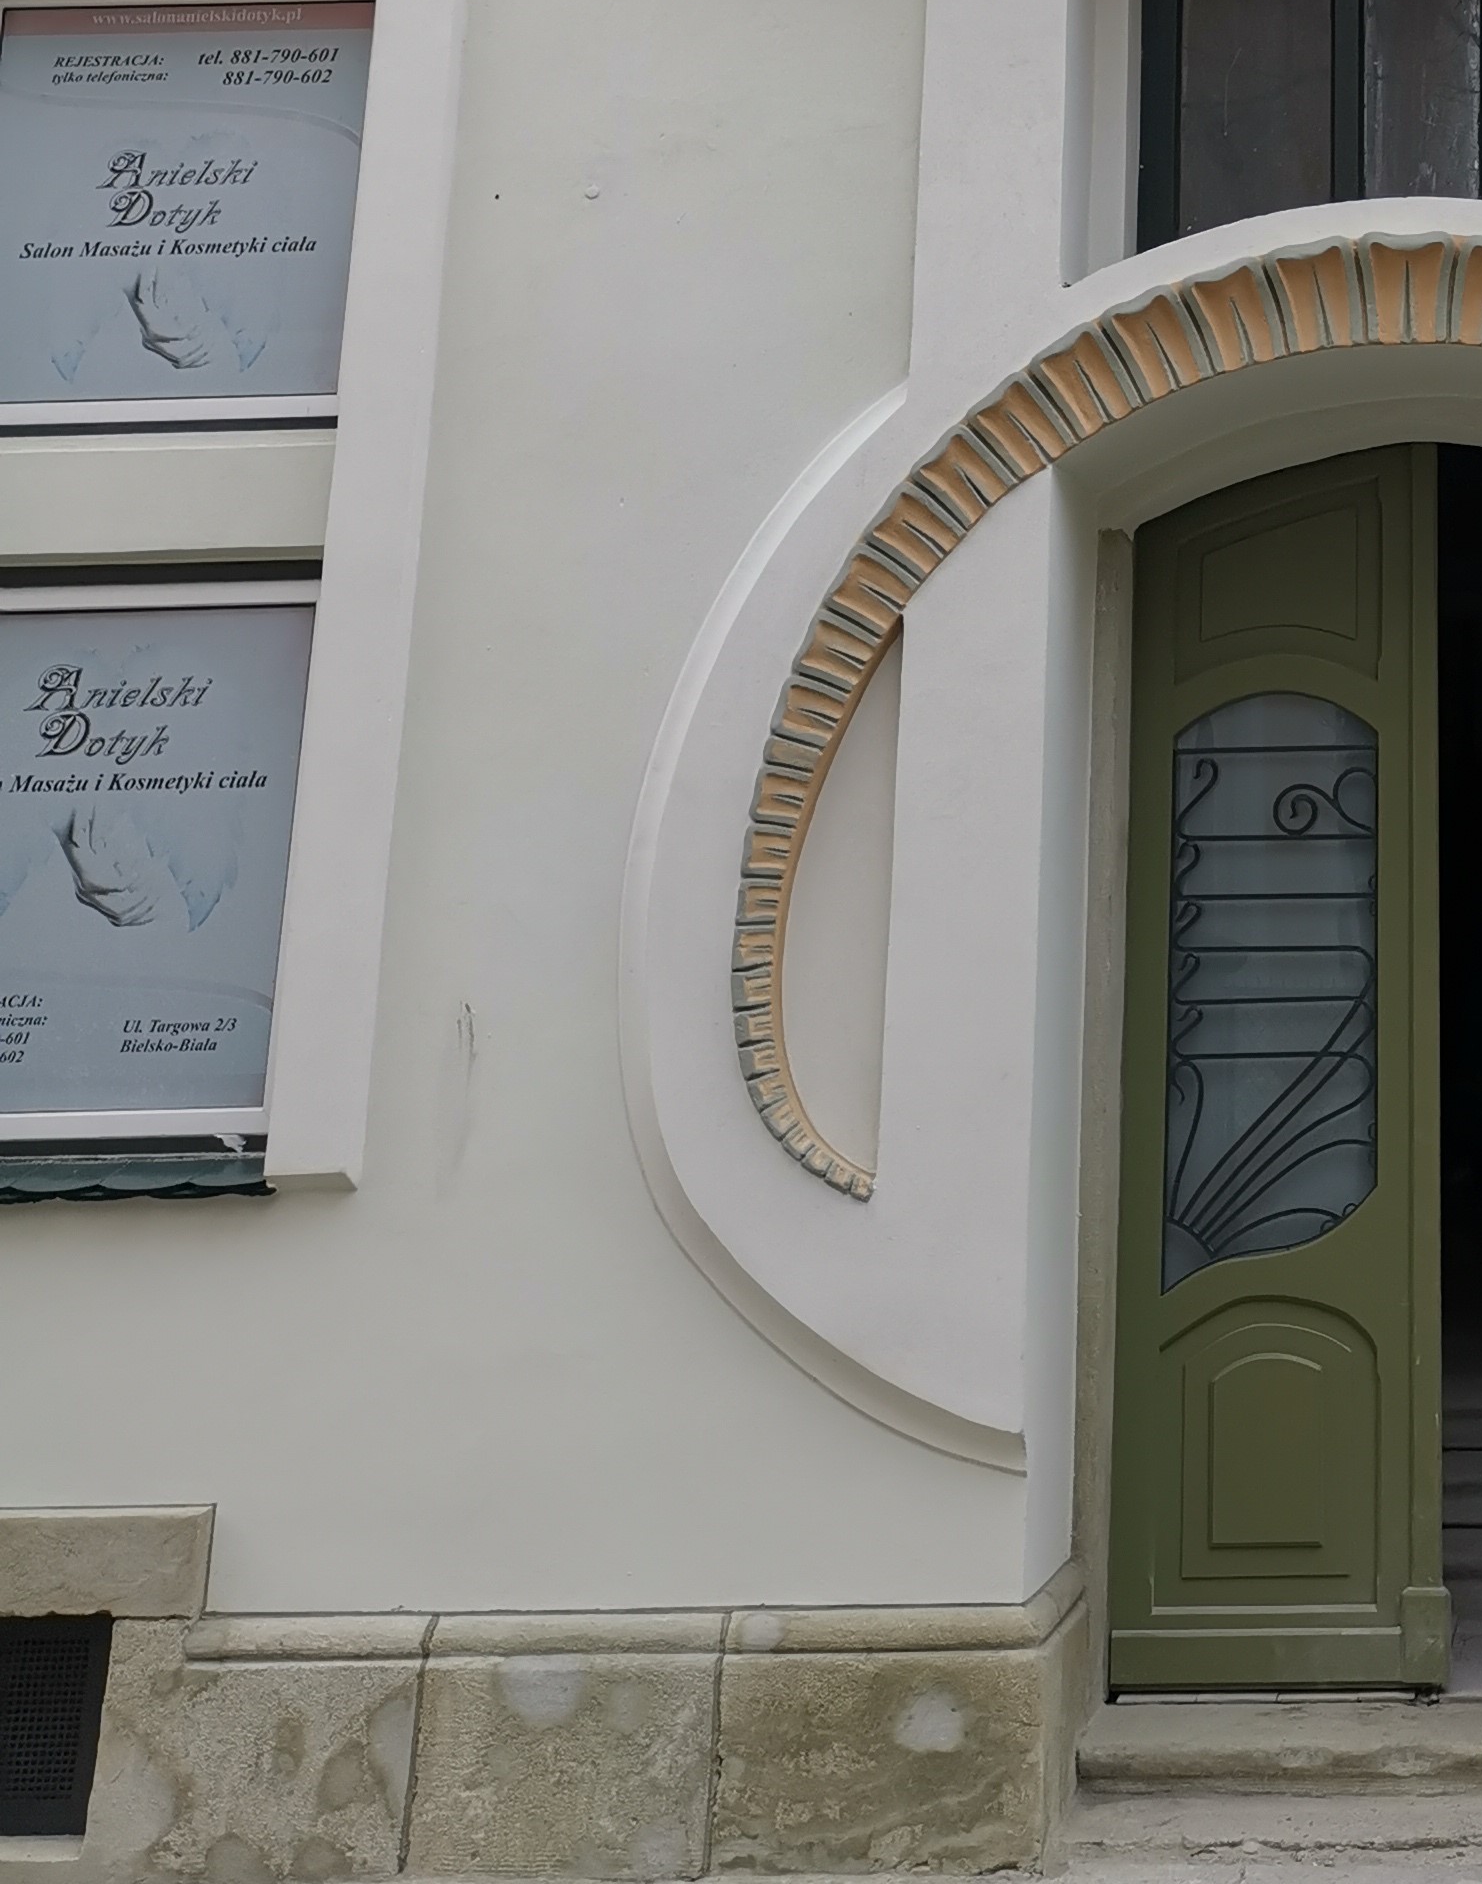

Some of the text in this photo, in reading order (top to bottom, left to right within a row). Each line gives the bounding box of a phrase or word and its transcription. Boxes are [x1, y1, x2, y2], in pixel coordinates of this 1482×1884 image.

[92, 8, 302, 25] www.salonanielskidotyk.pl
[53, 54, 164, 68] REJESTRACJA:
[198, 47, 339, 65] tel. 881-790-601
[51, 69, 169, 86] tylko telefoniczna:
[222, 68, 333, 85] 881-790-602
[96, 149, 258, 189] Anielski
[106, 189, 223, 234] Dotyk
[19, 242, 74, 259] Salon
[79, 240, 152, 258] Masażu
[157, 238, 167, 256] i
[170, 236, 268, 259] Kosmetyki
[24, 664, 213, 711] Anielski
[35, 711, 170, 765] Dotyk
[8, 774, 89, 794] Masażu
[94, 773, 104, 791] i
[107, 771, 215, 795] Kosmetyki
[123, 1017, 238, 1037] Ul. Targowa 2/3
